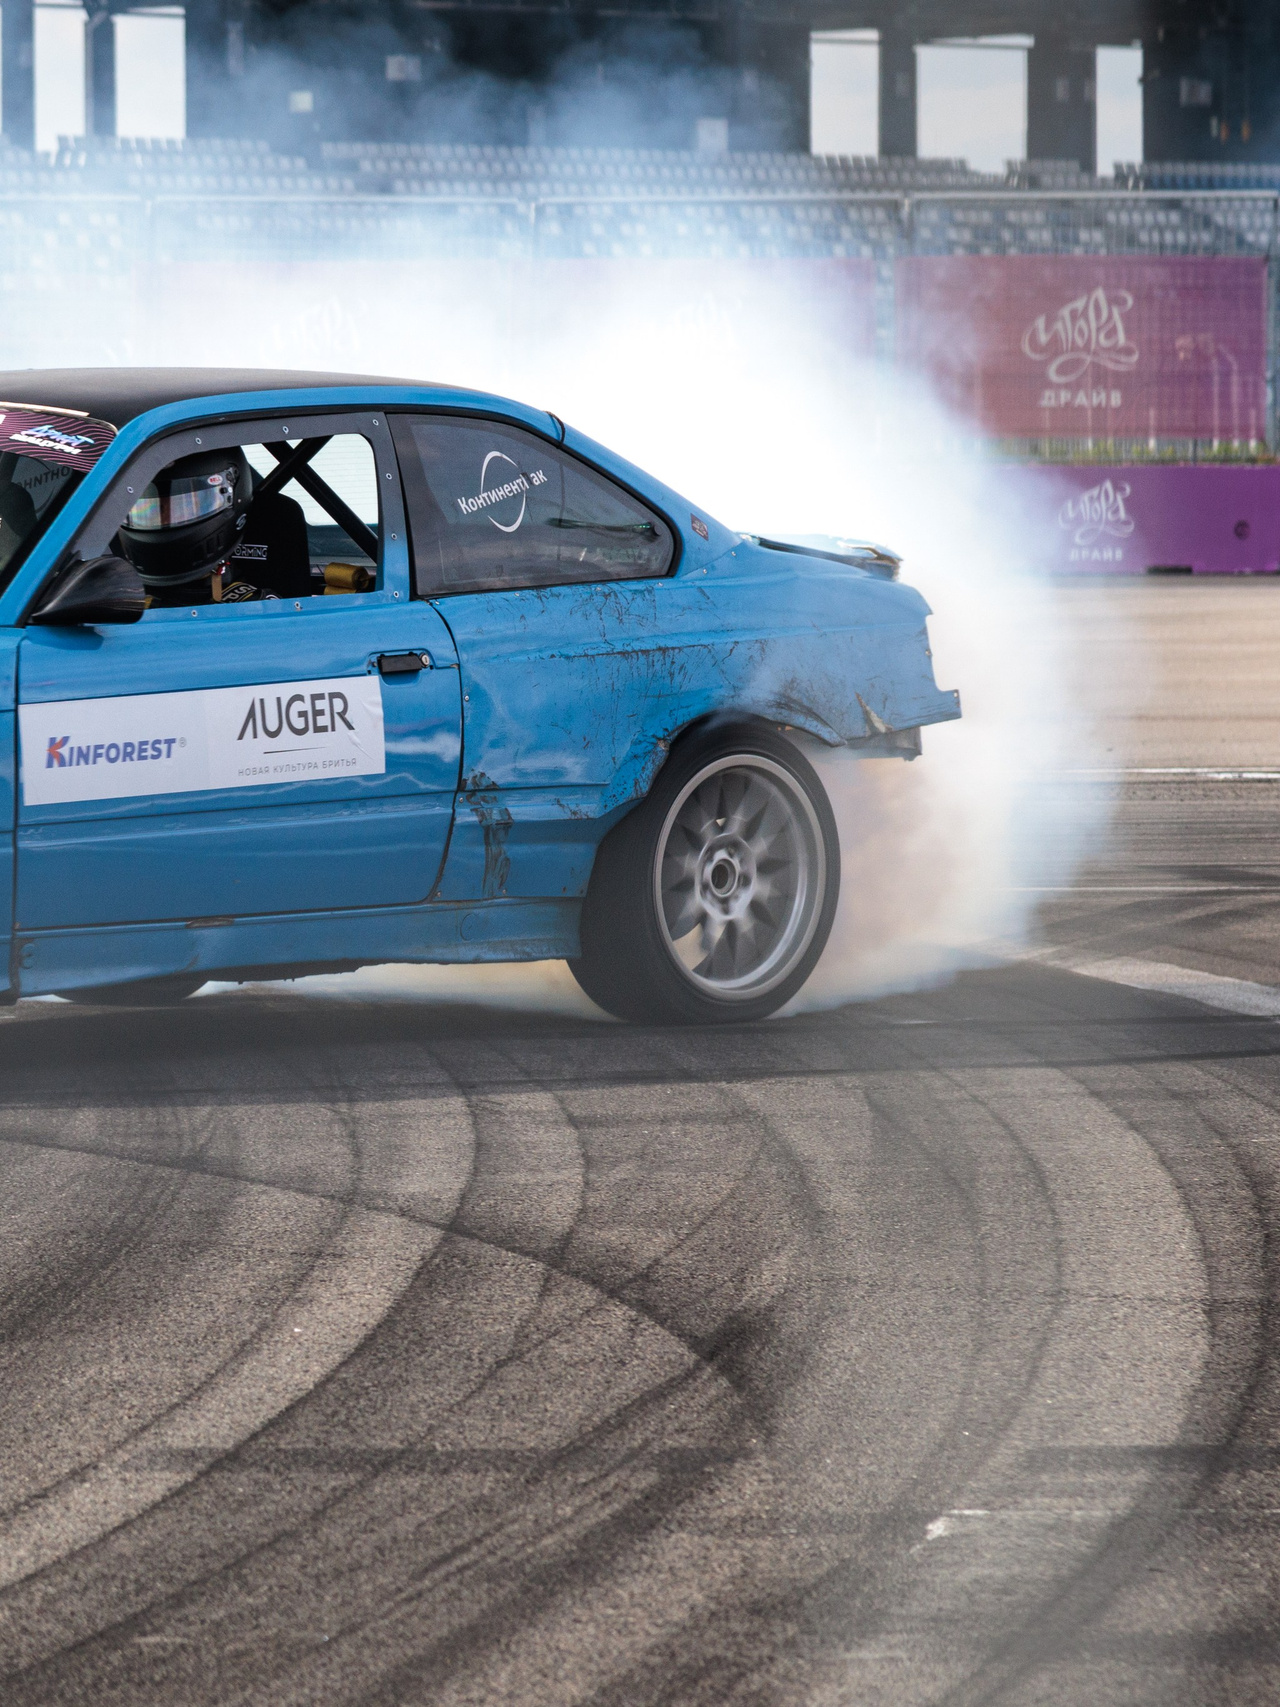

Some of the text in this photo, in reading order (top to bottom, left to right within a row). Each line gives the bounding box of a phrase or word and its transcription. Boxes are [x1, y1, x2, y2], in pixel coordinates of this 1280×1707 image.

[1038, 388, 1122, 409] ДРАЙВ
[236, 691, 355, 741] AUGER
[238, 757, 357, 777] НОВАЯ КУЛЬТУРА БРИТЬЯ
